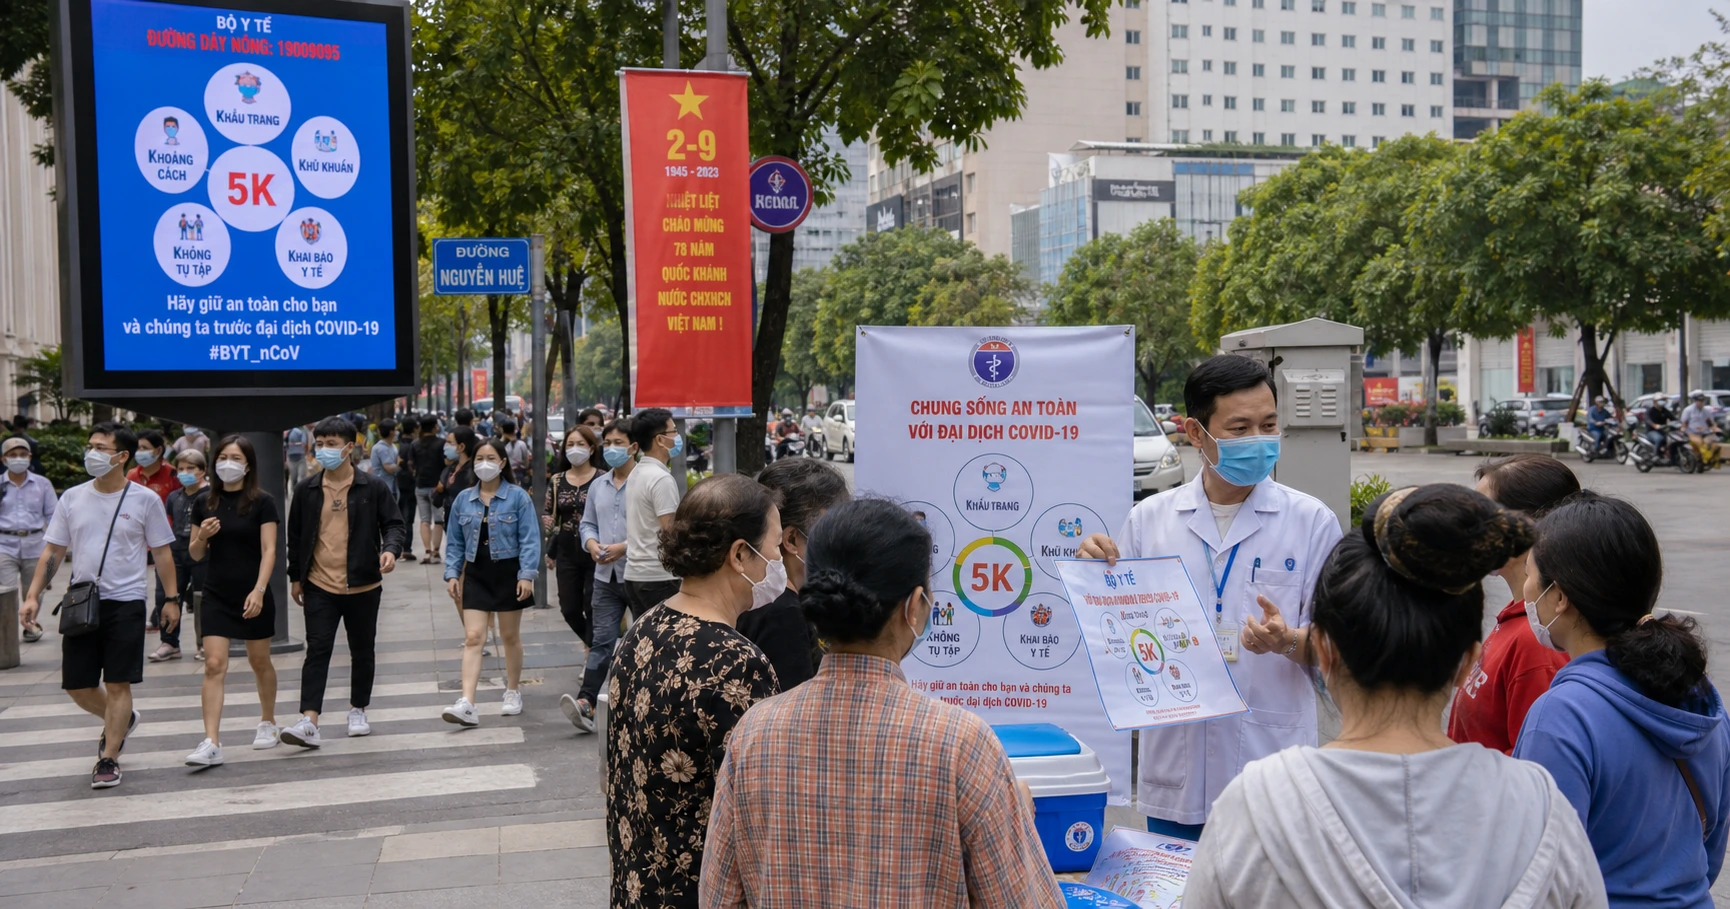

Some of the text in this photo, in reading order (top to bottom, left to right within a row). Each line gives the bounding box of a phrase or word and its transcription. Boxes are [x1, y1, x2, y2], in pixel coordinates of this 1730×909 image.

[217, 14, 237, 33] BỘ
[241, 18, 250, 32] Y
[247, 114, 280, 126] TRANG
[666, 128, 716, 161] 2-9
[665, 166, 688, 177] 1945
[696, 166, 719, 178] 2023
[227, 172, 277, 207] 5K
[699, 191, 720, 211] LIỆT
[288, 250, 311, 263] KHAI
[456, 243, 510, 258] ĐƯỜNG
[674, 242, 687, 257] 78
[301, 267, 308, 277] Y
[499, 264, 525, 290] HUỆ
[662, 262, 690, 284] QUỐC
[226, 299, 244, 311] an
[247, 296, 279, 312] toàn
[283, 297, 308, 312] cho
[312, 297, 337, 316] bạn
[123, 318, 379, 339] và chúng ta trước đại dịch COVID-19
[667, 312, 723, 334] VIỆT NAM !
[209, 345, 300, 363] #BYT_nCoV
[910, 395, 1077, 415] CHUNG SỐNG AN TOÀN
[908, 421, 1079, 443] VỚI ĐẠI DỊCH COVID-19
[971, 562, 1014, 592] 5K
[1117, 574, 1123, 586] Y
[1020, 634, 1040, 644] KHAI
[1030, 648, 1037, 657] Y
[1138, 643, 1159, 662] 5K
[946, 682, 957, 690] an
[981, 681, 998, 692] cho
[1062, 684, 1071, 694] ta
[1004, 697, 1047, 709] COVID-19
